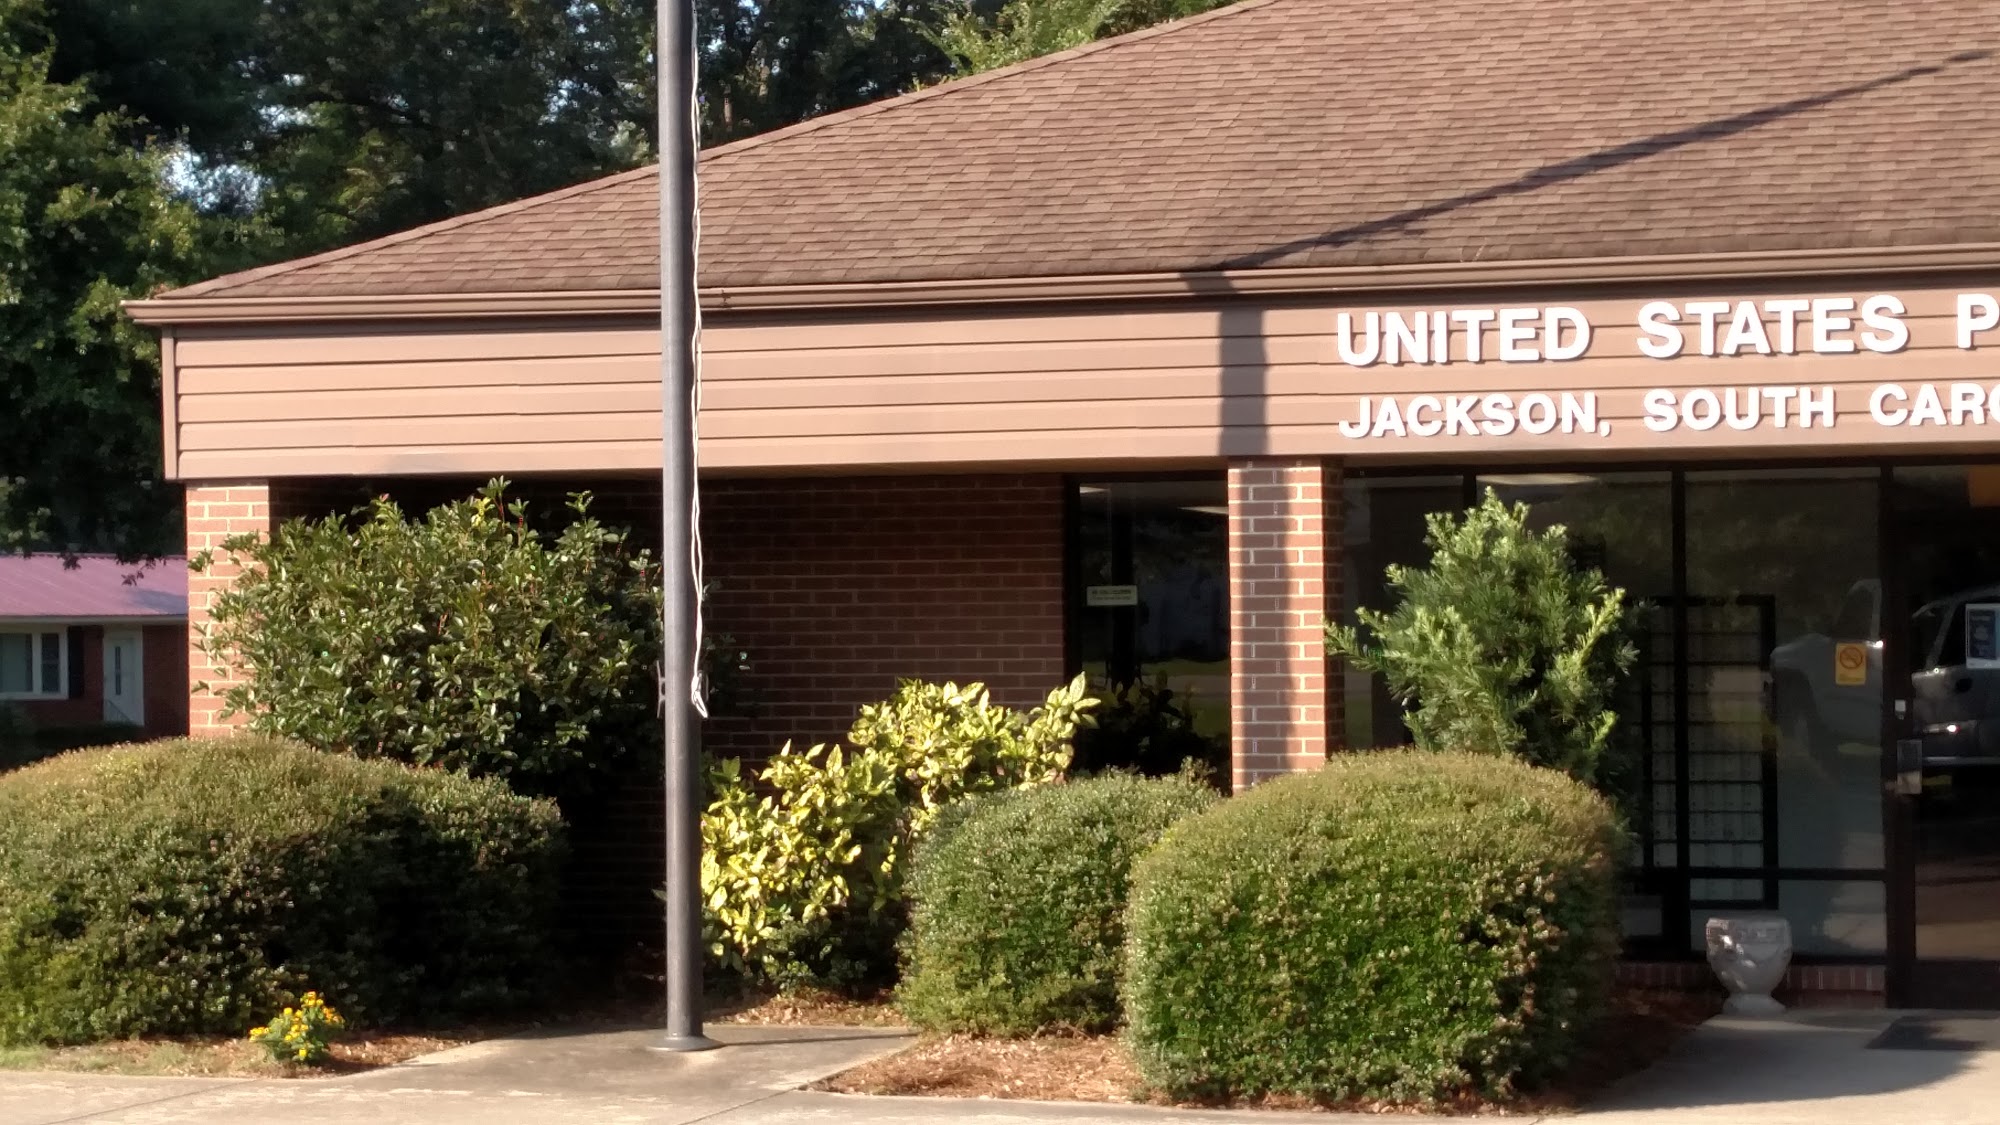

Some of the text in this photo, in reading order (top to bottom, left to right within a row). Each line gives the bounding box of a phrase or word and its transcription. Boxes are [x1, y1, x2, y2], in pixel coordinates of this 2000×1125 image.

[1336, 293, 2000, 366] UNITED STATES P
[1339, 391, 1612, 438] JACKSON,
[1643, 387, 1835, 432] SOUTH
